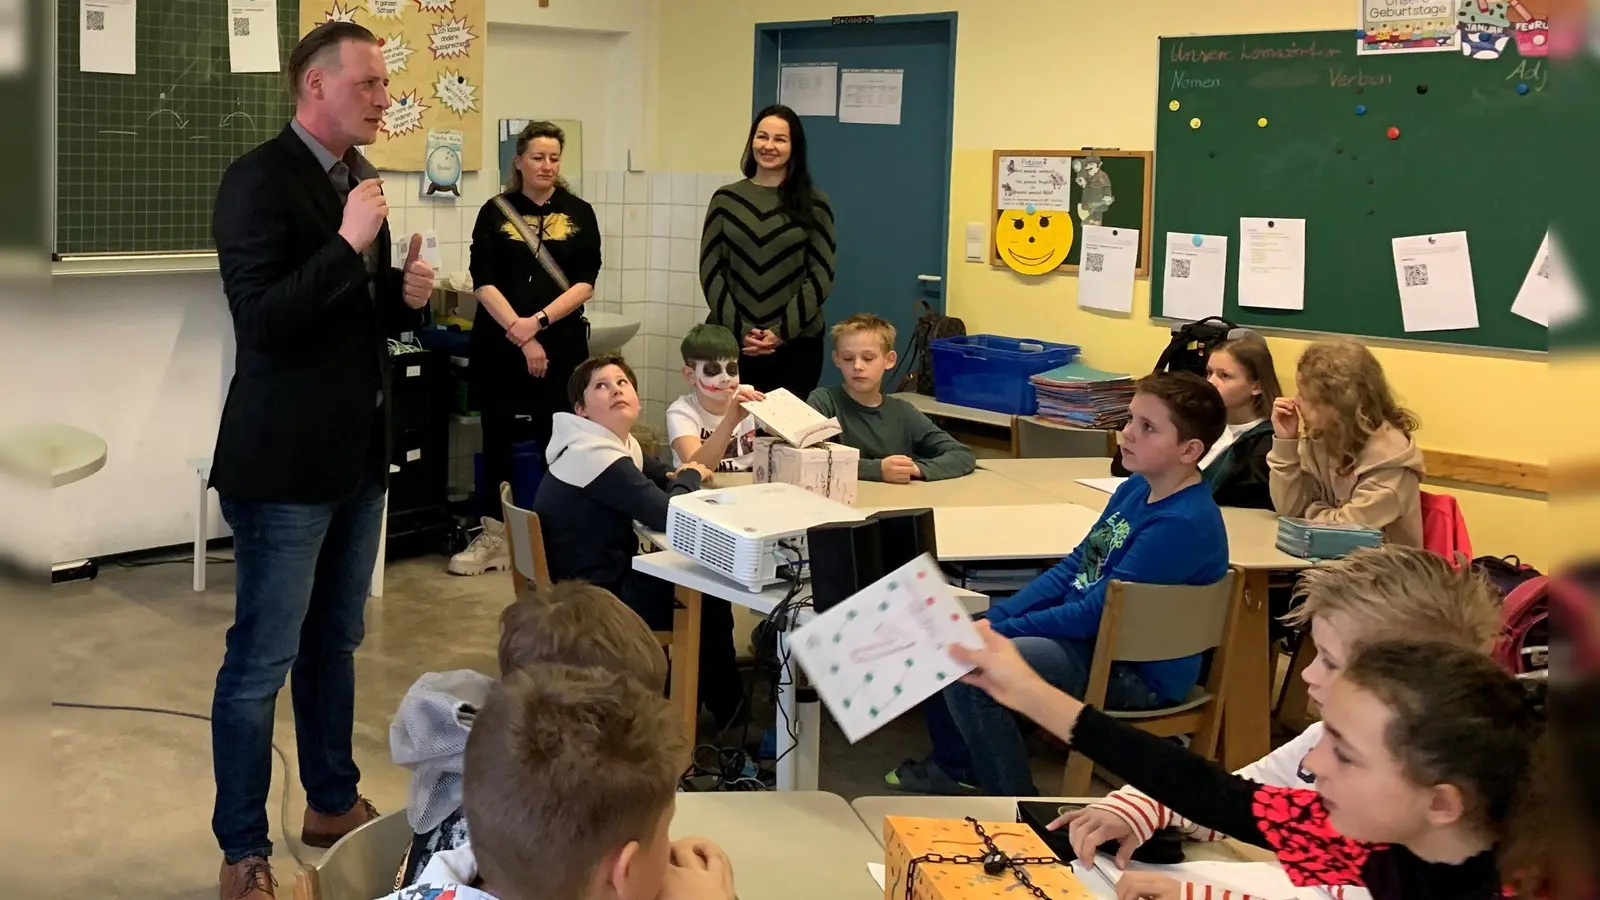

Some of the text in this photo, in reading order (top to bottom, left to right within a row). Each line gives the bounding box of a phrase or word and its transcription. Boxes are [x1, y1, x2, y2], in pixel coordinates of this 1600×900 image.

[1369, 7, 1447, 18] Geburtstage
[1464, 23, 1503, 34] JANUAR
[1171, 71, 1220, 91] Nomen
[1329, 68, 1392, 87] Verben
[1505, 59, 1547, 92] Adj
